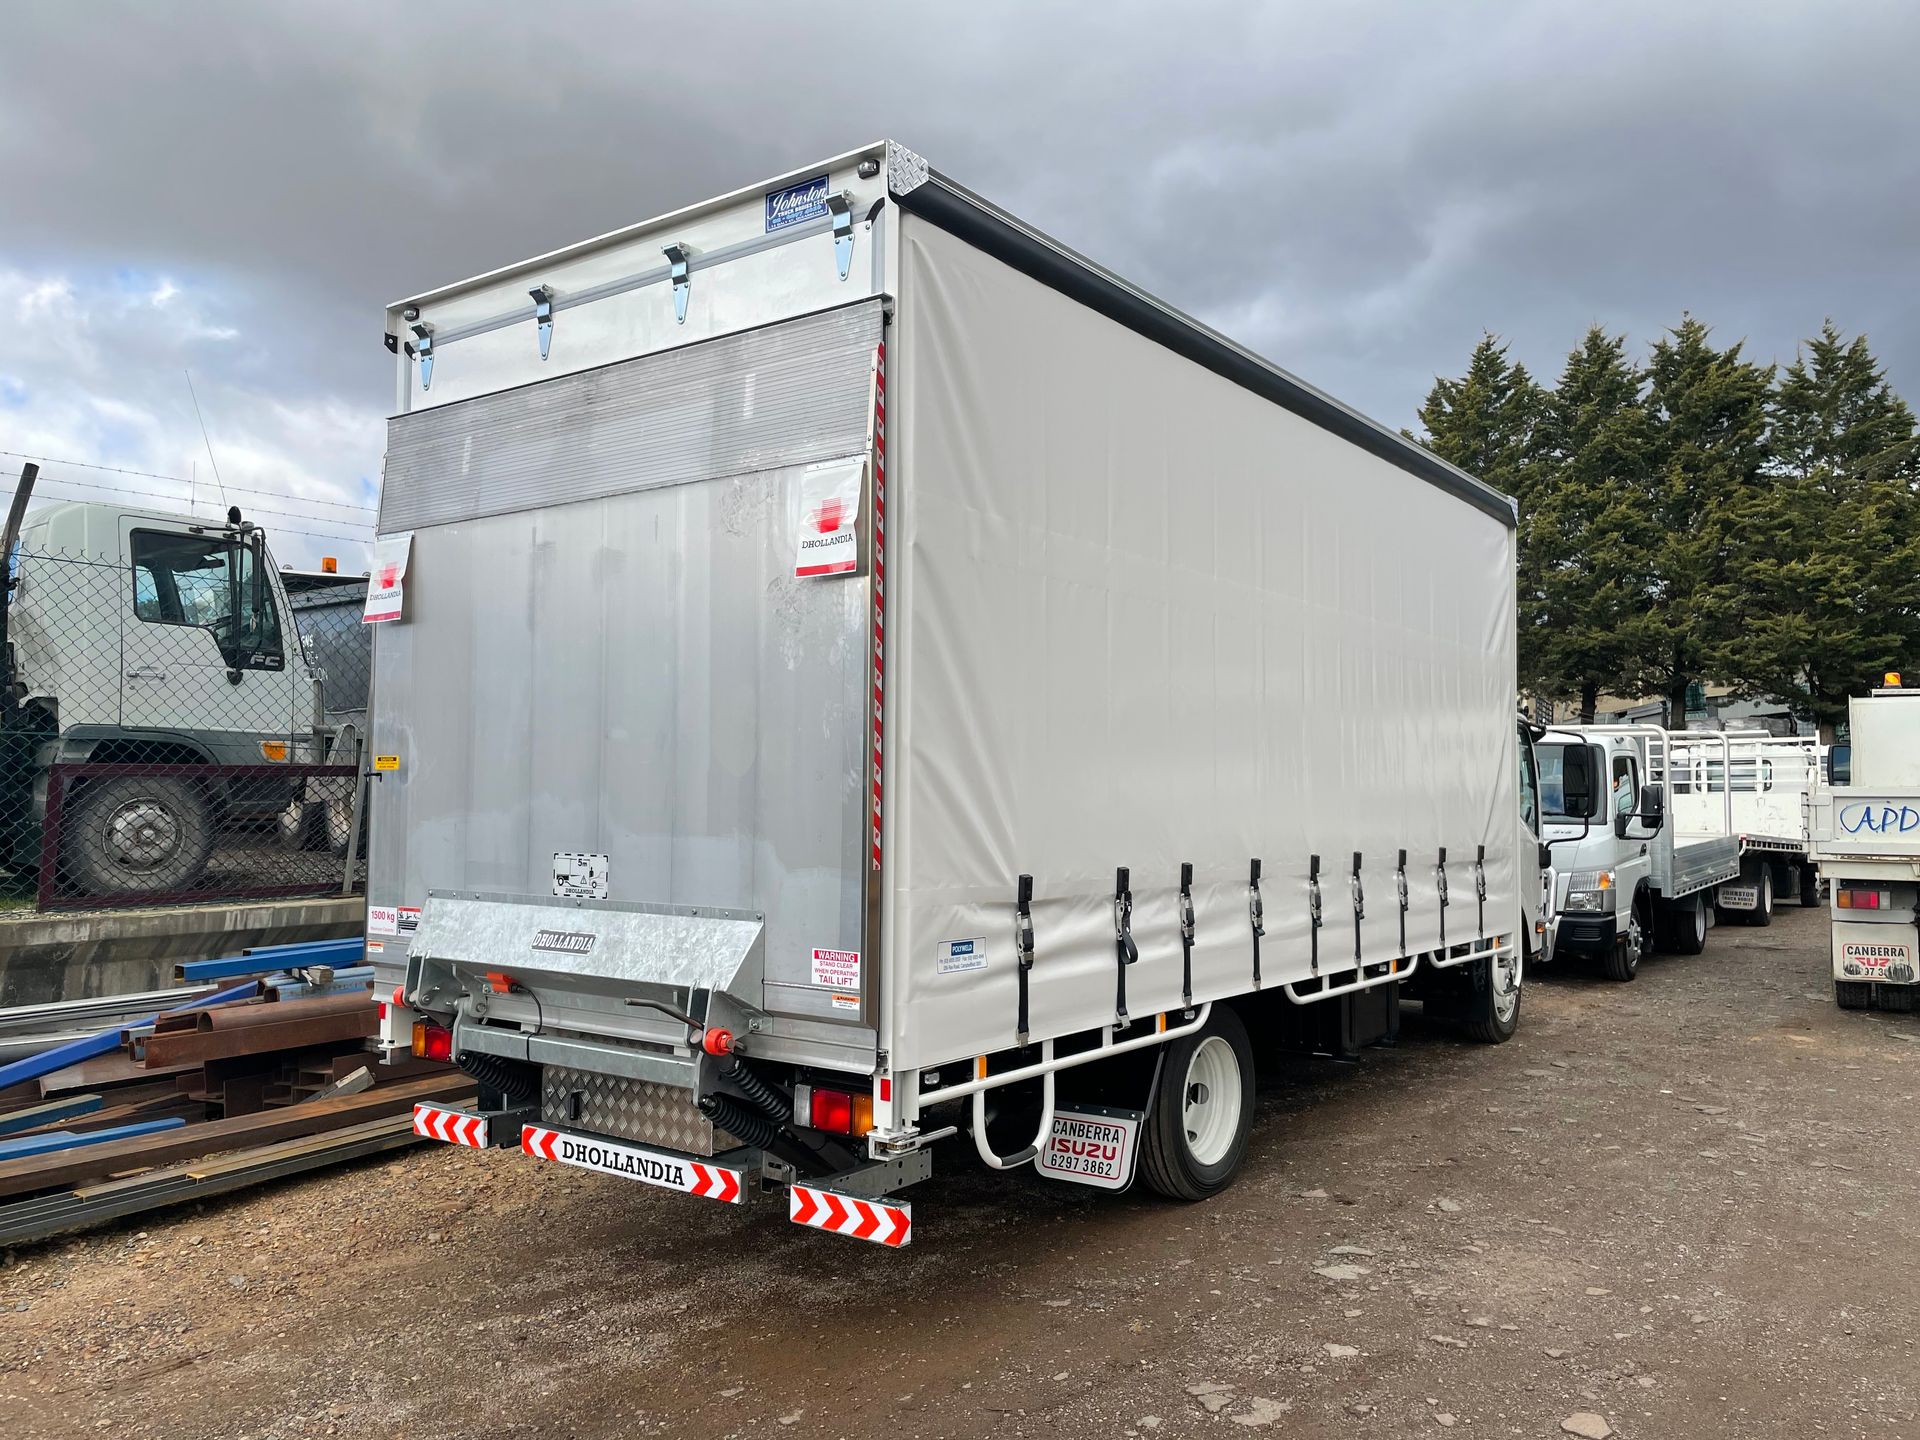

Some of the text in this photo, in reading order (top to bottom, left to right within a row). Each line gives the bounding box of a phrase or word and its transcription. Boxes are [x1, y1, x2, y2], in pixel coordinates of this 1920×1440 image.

[767, 186, 828, 219] Johnston
[802, 533, 853, 549] DHOLLANDIA
[250, 655, 281, 667] FC
[371, 910, 395, 923] 1500 kg
[532, 933, 595, 951] DHOLLANDIA
[818, 950, 855, 963] WARNING
[1846, 945, 1905, 957] CANBERRA
[819, 975, 854, 986] TAIL LIFT
[829, 969, 858, 977] OPERATING
[1052, 1120, 1120, 1143] CANBERRA
[1050, 1137, 1117, 1161] ISUZU
[562, 1140, 686, 1187] DHOLLANDIA
[1051, 1153, 1112, 1176] 6297 3862
